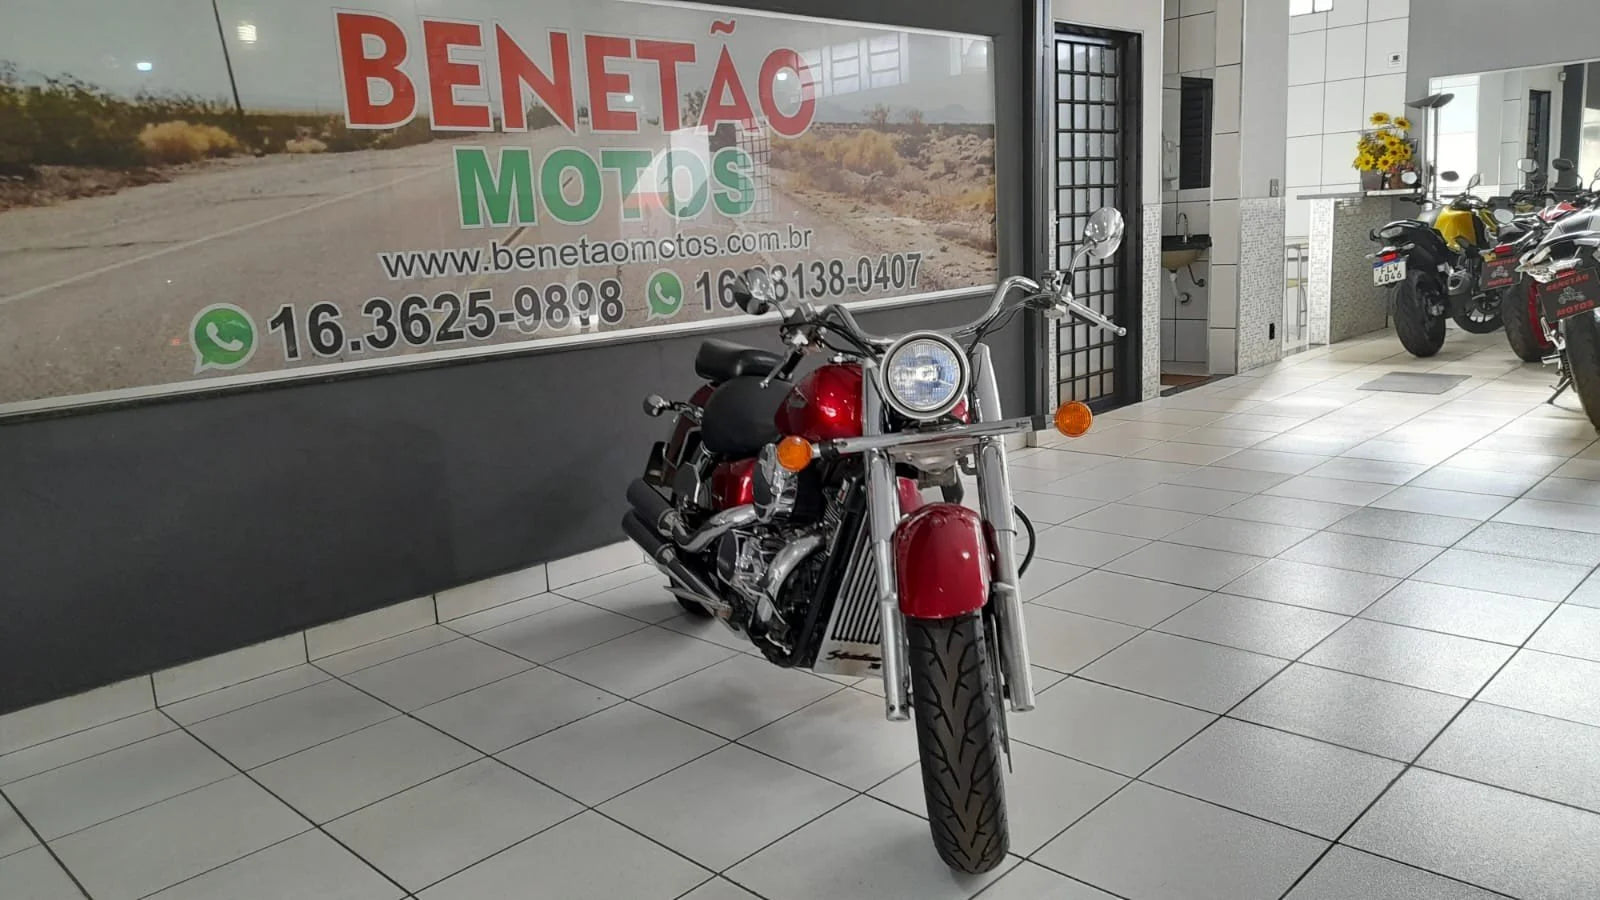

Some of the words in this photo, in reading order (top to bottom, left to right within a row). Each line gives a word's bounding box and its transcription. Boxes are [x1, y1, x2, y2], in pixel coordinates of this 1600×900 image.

[334, 11, 817, 137] BENETÃO
[454, 147, 755, 228] MOTOS
[382, 226, 812, 279] www.benetaomotos.com.br
[267, 279, 625, 361] 16.3625-9898
